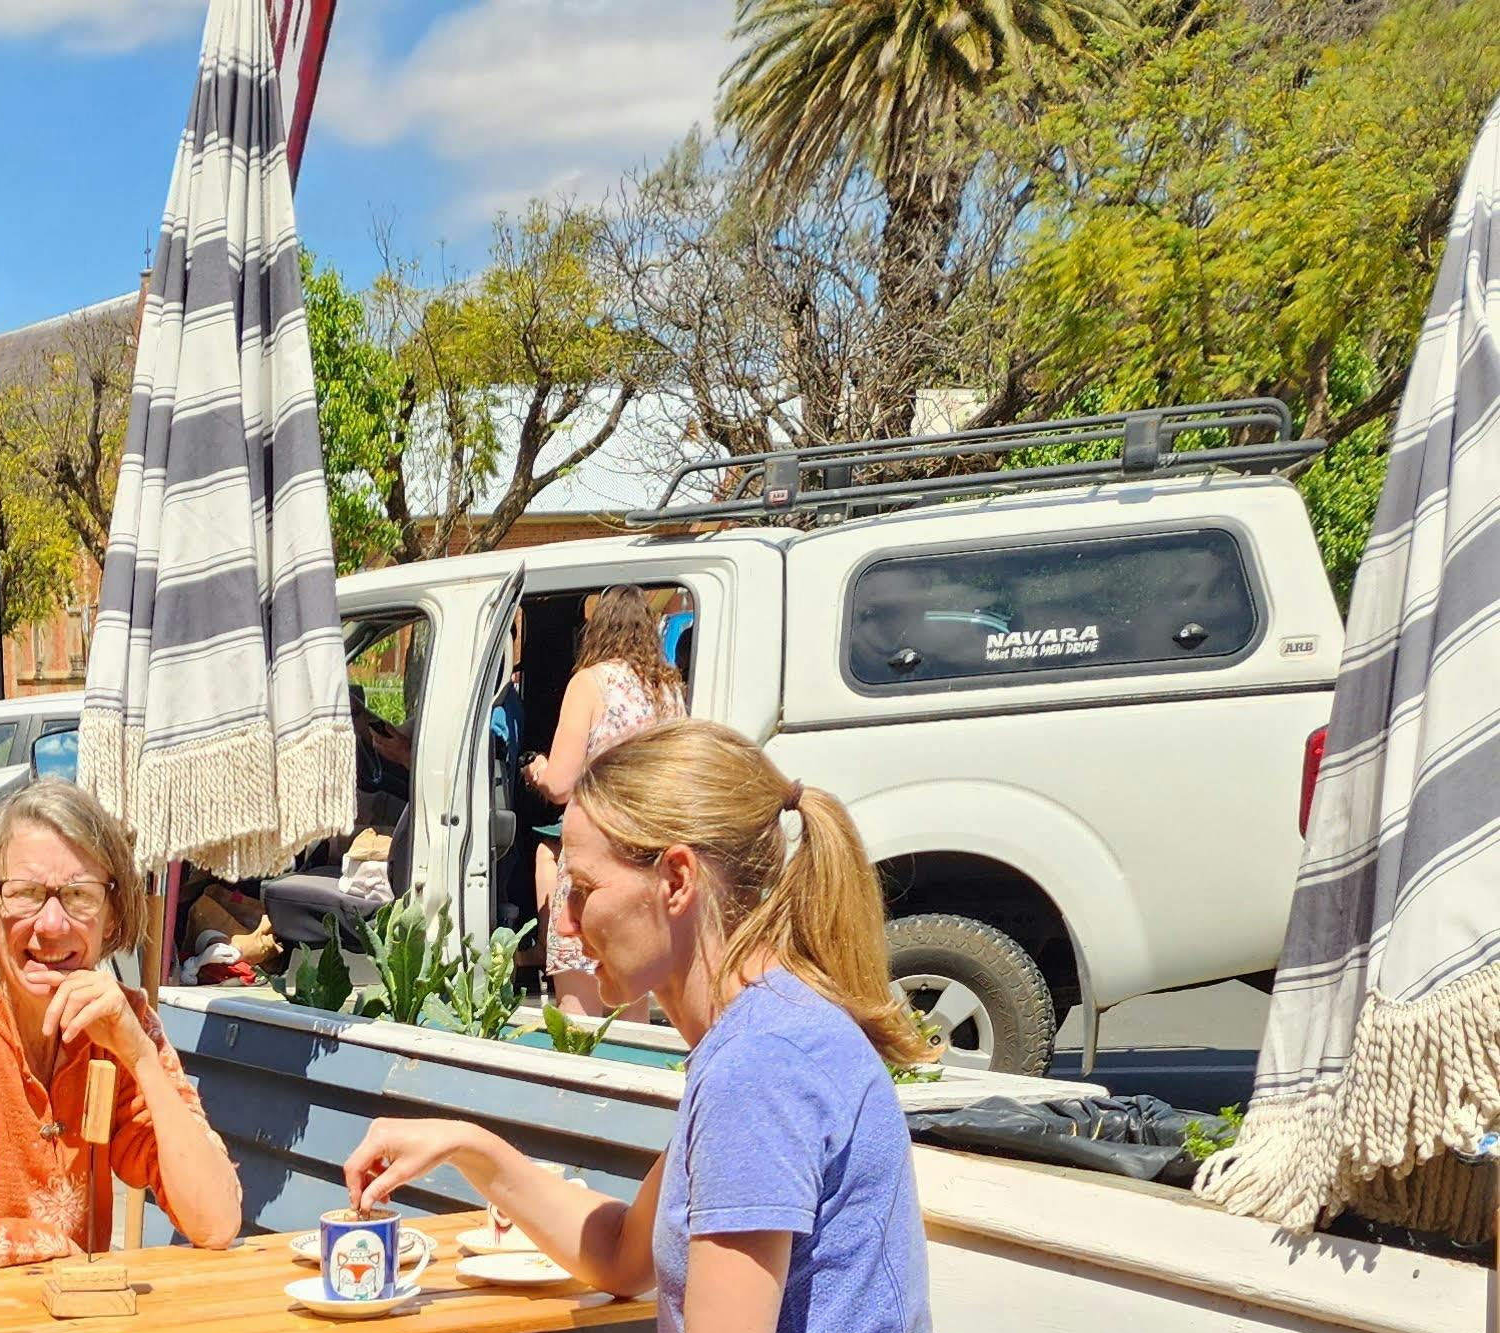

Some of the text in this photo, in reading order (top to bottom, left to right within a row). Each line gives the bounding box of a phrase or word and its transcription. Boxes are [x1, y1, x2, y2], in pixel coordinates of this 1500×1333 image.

[987, 625, 1098, 648] NAVARA
[1011, 645, 1038, 659] REAL
[1040, 643, 1065, 657] MEN
[1065, 640, 1099, 654] DRIVE
[1284, 642, 1313, 653] ARB
